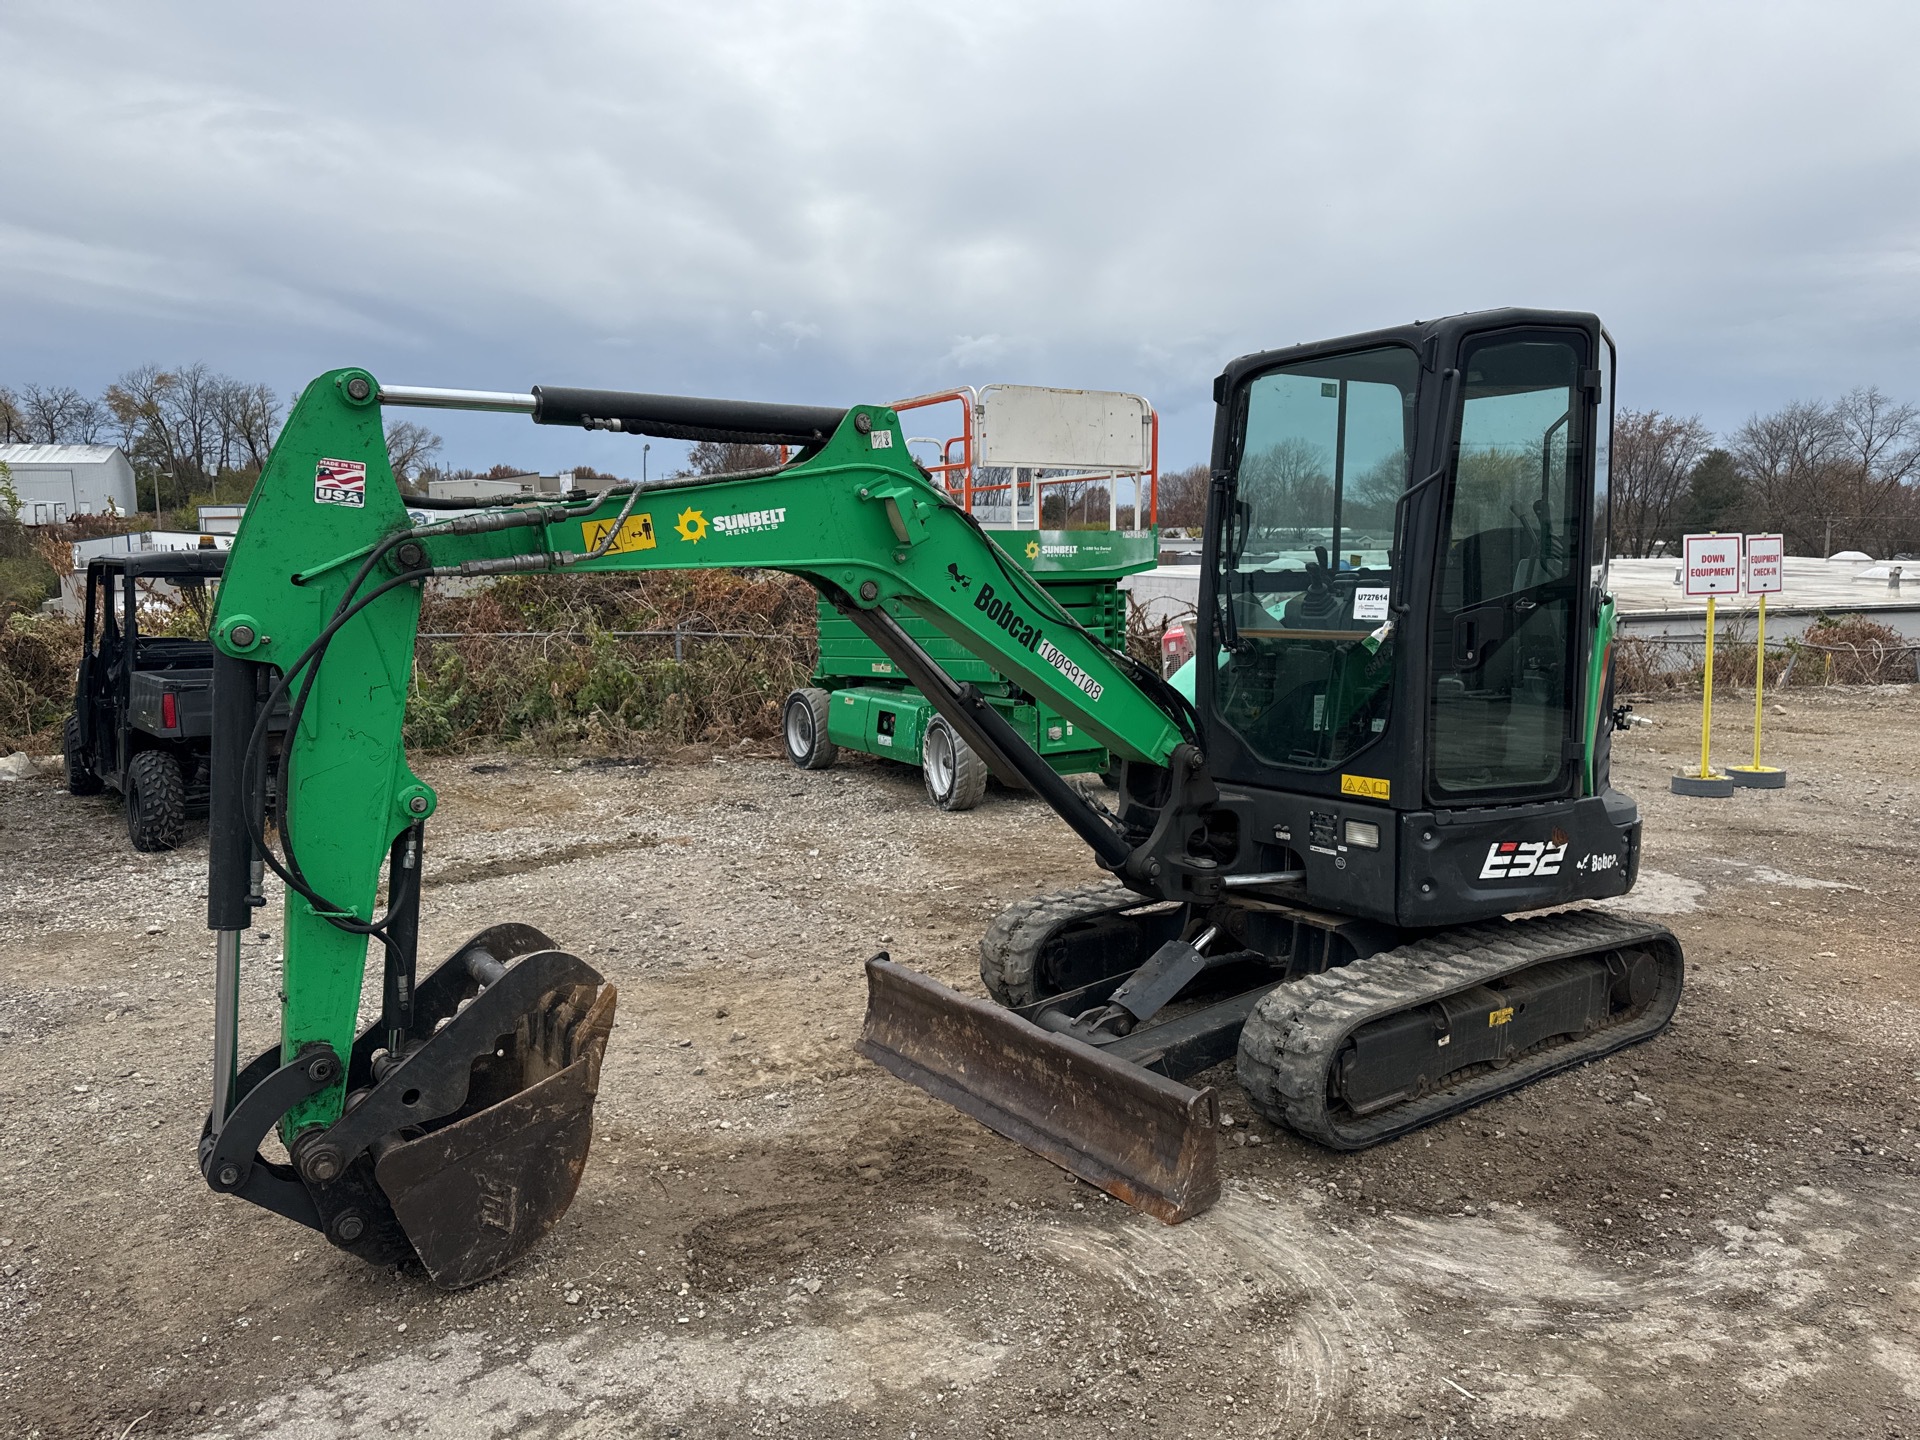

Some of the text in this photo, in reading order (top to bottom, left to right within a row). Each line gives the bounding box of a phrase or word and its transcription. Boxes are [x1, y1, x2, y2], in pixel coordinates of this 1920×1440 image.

[320, 460, 340, 468] MADE
[318, 488, 361, 503] USA
[712, 507, 787, 532] SUNBELT
[725, 523, 779, 537] RENTALS
[1041, 545, 1078, 555] SUNBELT
[1701, 554, 1725, 563] DOWN
[1751, 554, 1779, 564] EQUIPMENT
[1690, 567, 1735, 577] EQUIPMENT
[1753, 567, 1777, 577] CHECK-IN
[973, 582, 1043, 653] Bobcat
[1040, 642, 1102, 700] 10099108
[1478, 841, 1569, 880] E32
[1591, 853, 1618, 872] Bobc
